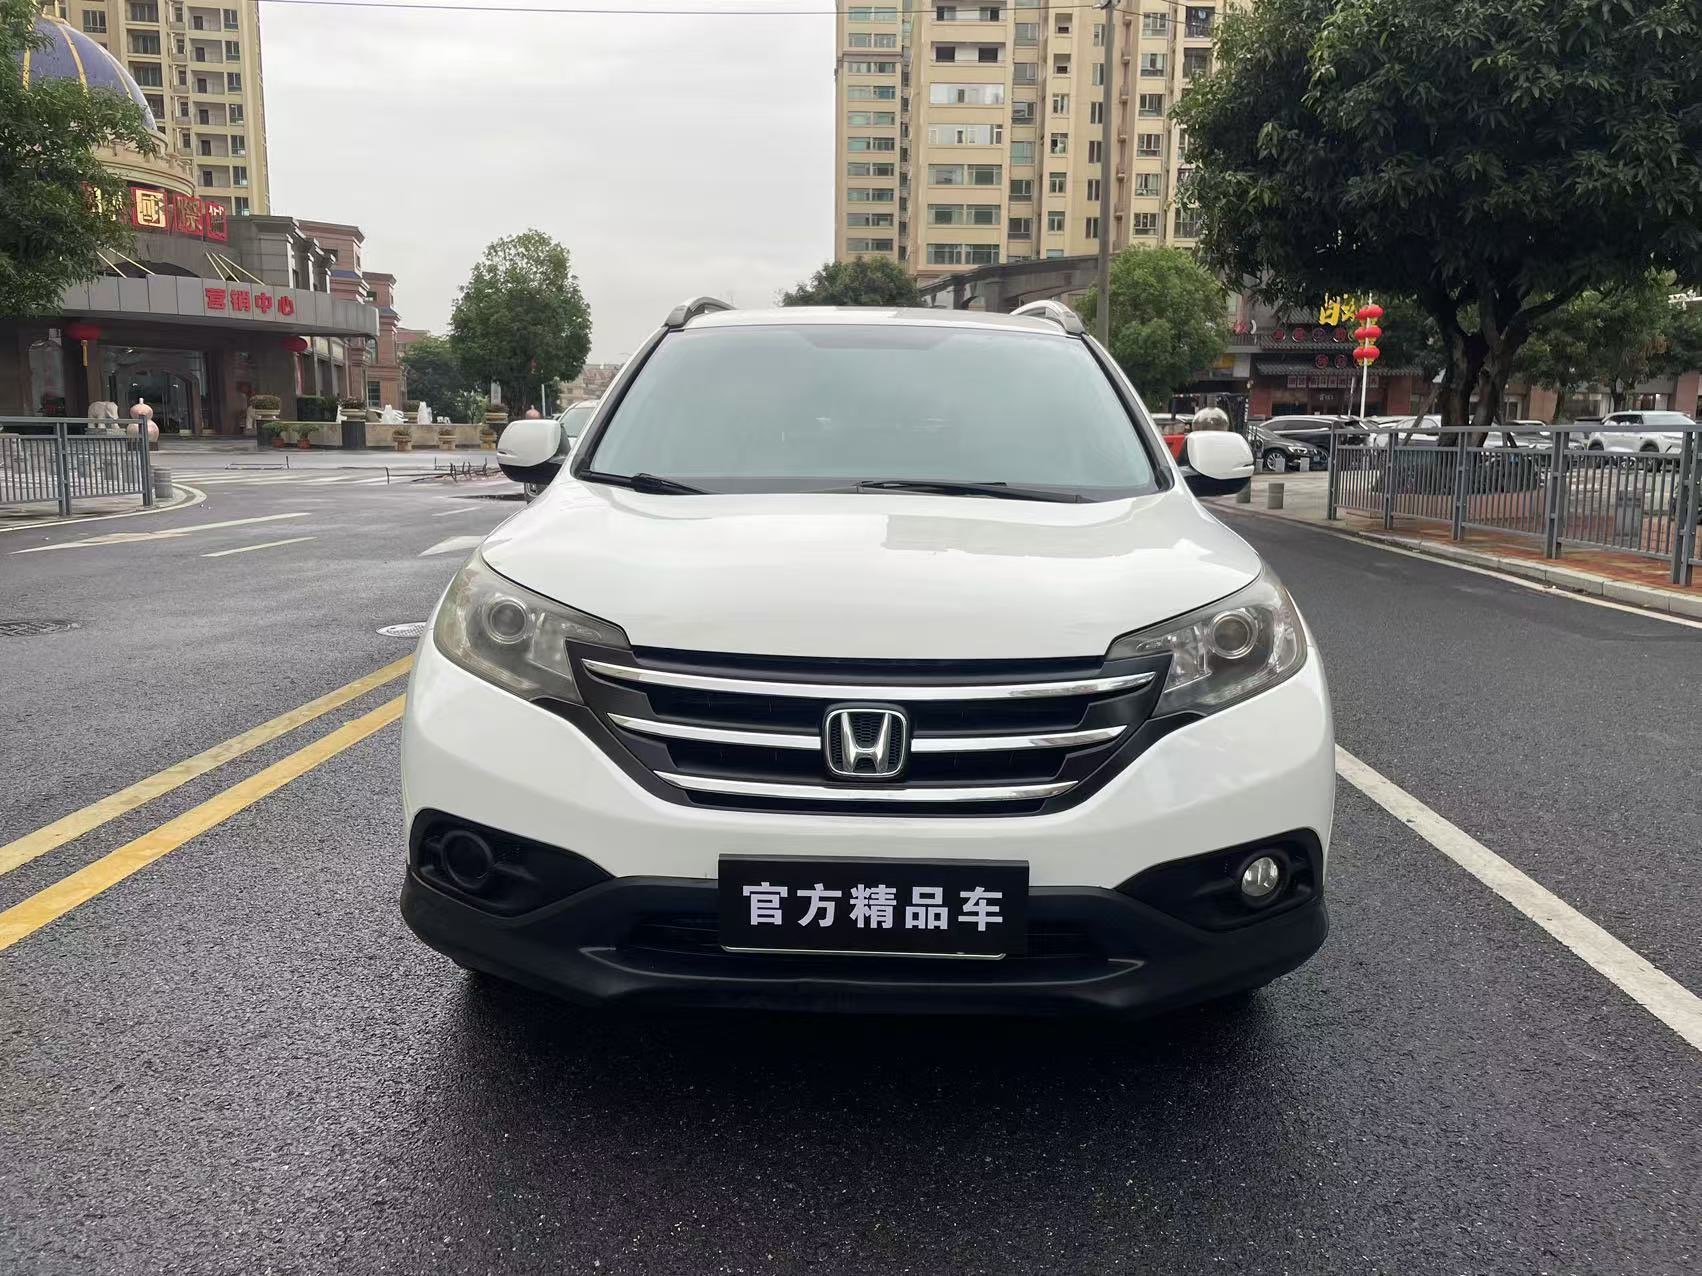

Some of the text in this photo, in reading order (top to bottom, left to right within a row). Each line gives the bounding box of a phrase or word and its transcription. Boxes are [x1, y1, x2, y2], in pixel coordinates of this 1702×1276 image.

[205, 287, 295, 316] 营销中心
[742, 881, 1003, 932] 官方精品车
